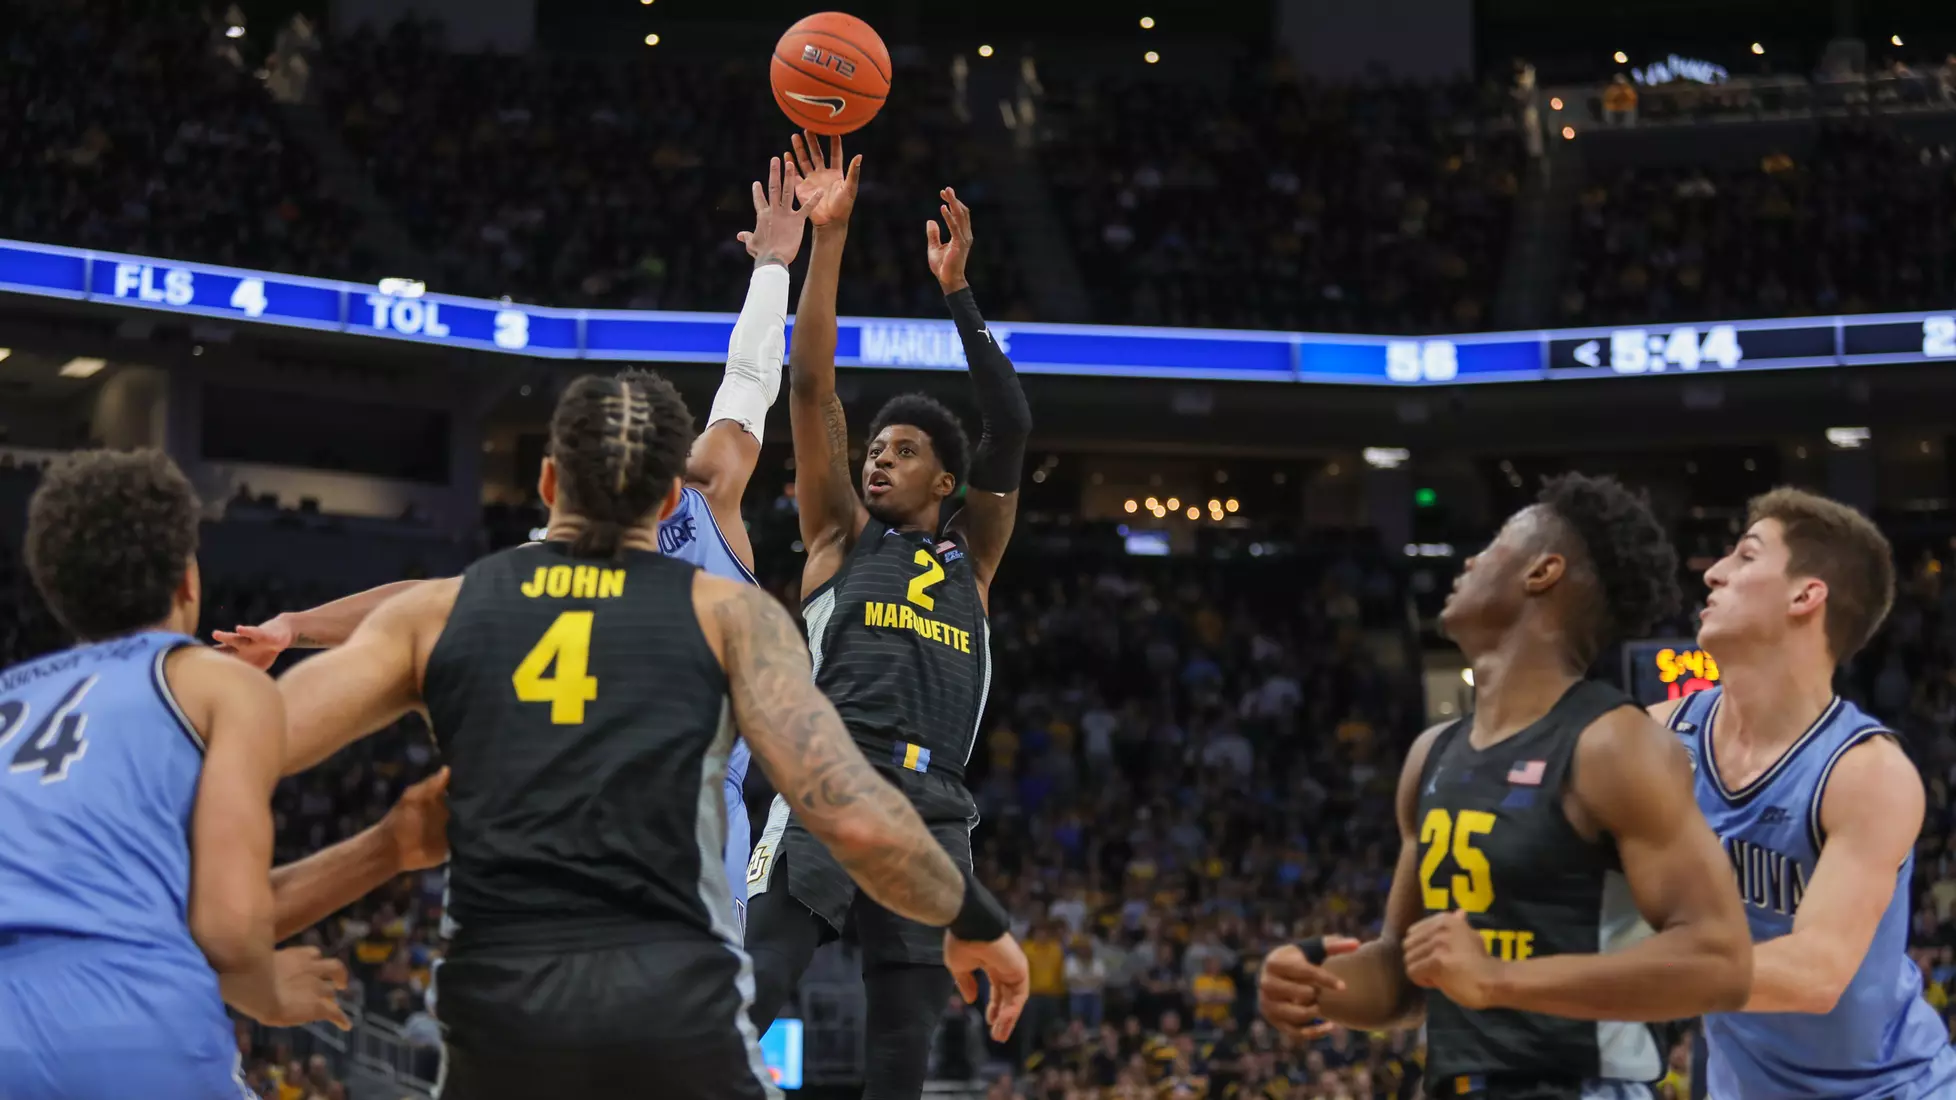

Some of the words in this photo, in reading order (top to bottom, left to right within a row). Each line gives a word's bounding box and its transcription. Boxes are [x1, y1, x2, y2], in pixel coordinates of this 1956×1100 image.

[115, 263, 195, 306] FLS
[230, 277, 268, 318] 4
[366, 294, 450, 337] TOL
[493, 309, 529, 350] 3
[1611, 325, 1742, 374] 5:44
[1385, 339, 1458, 382] 56
[521, 565, 626, 598] JOHN
[907, 549, 945, 611] 2
[865, 601, 970, 654] MARQUETTE
[511, 611, 598, 724] 4
[1419, 808, 1496, 913] 25
[1726, 834, 1806, 918] NOVA
[1479, 929, 1535, 962] TTE
